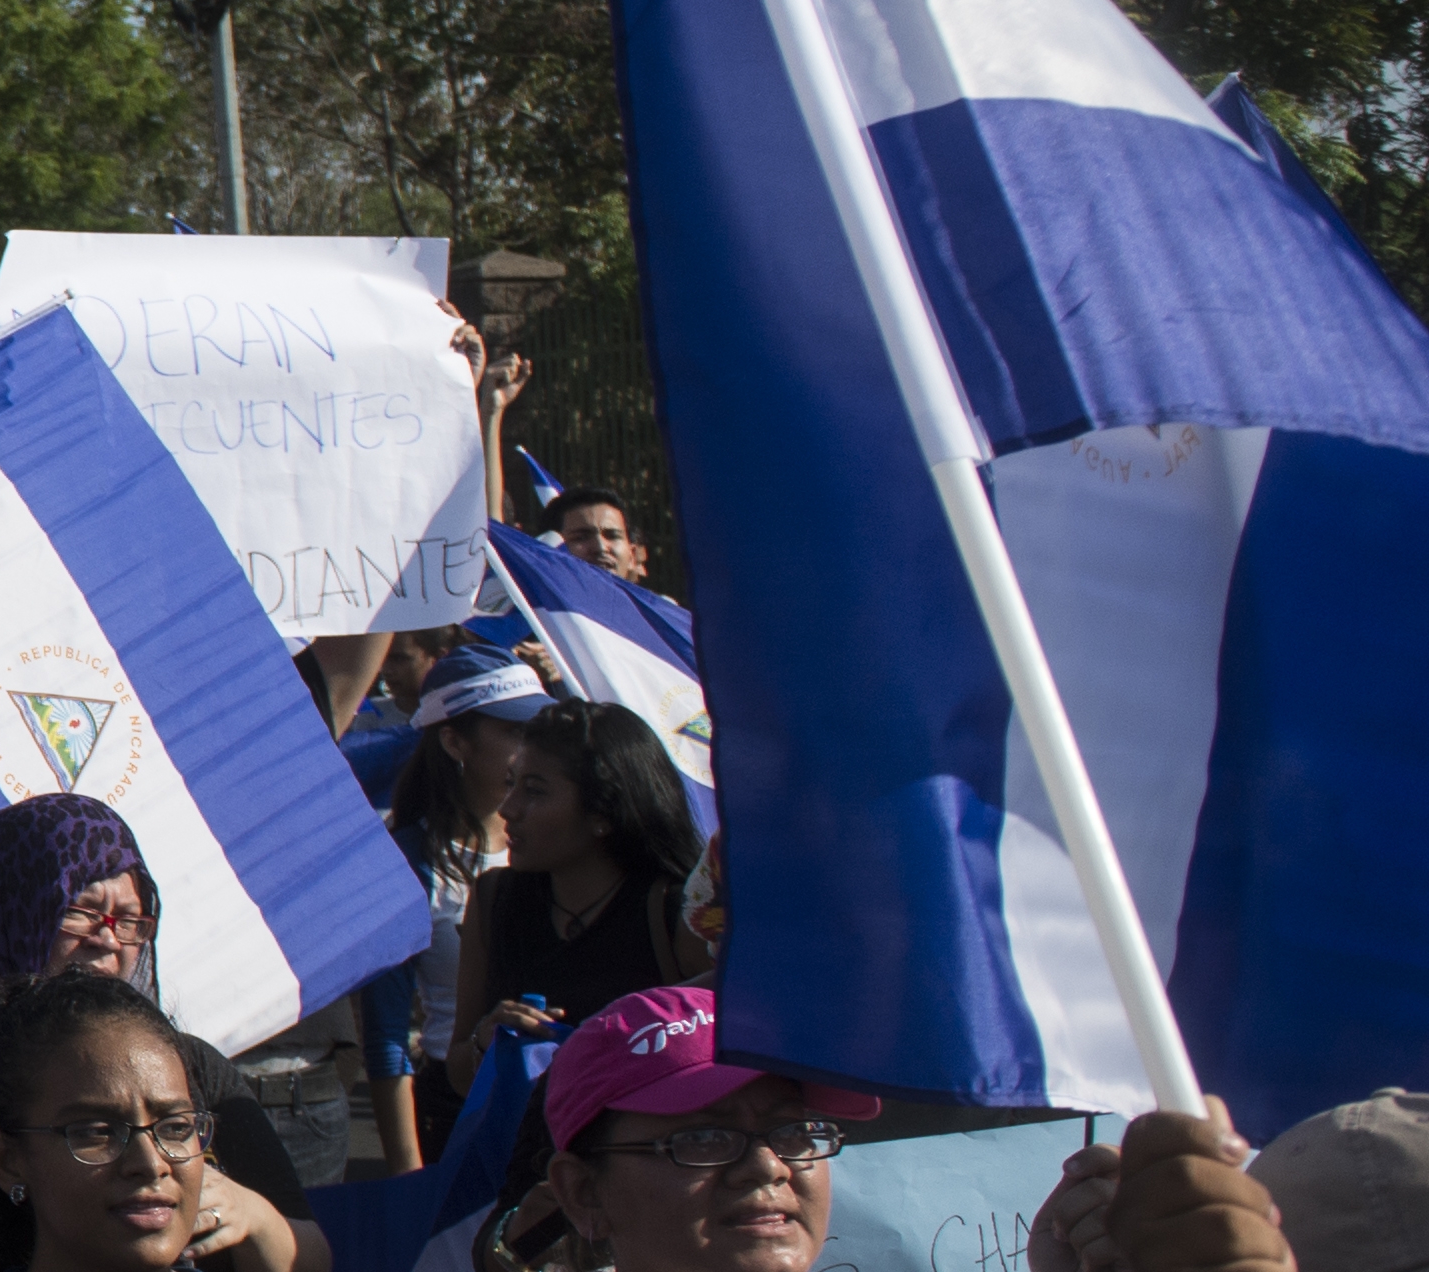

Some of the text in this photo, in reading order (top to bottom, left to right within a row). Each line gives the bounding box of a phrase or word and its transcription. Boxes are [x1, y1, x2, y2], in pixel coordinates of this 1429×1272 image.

[139, 294, 337, 378] ERAN
[19, 644, 143, 807] REPUBLICA DE NICARAGU
